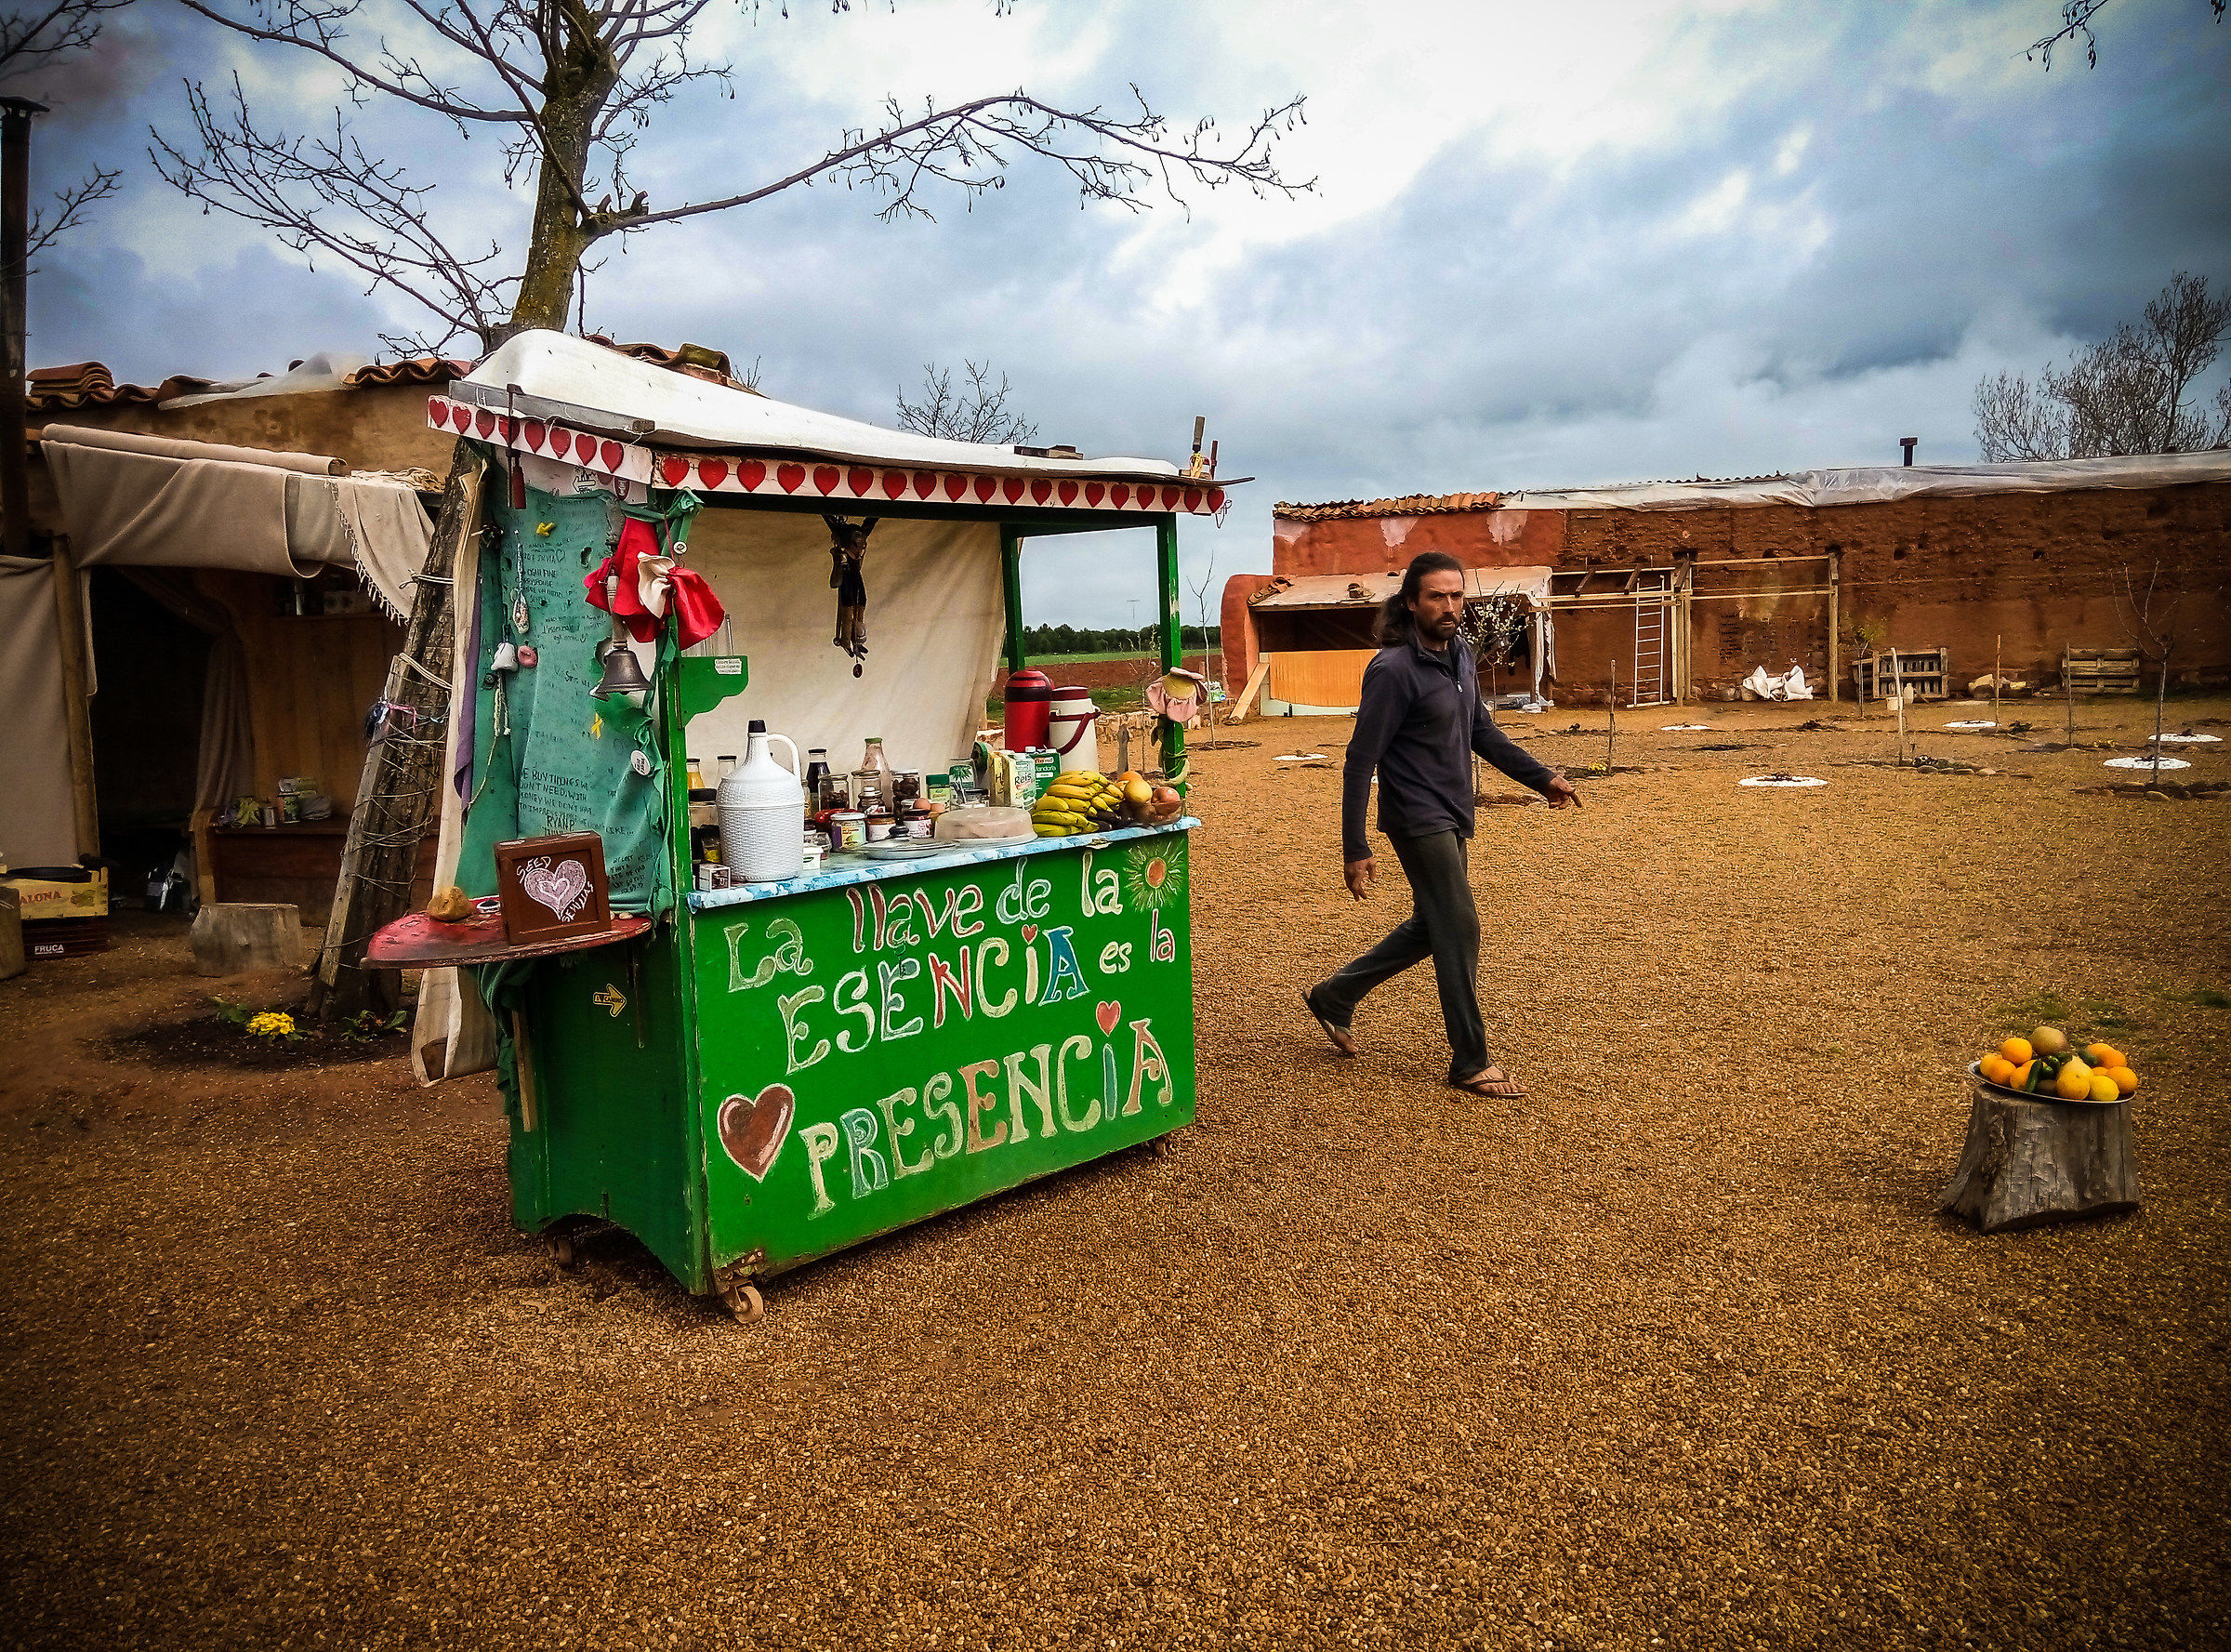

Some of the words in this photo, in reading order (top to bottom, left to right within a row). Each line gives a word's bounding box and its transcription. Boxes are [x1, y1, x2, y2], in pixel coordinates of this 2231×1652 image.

[533, 770, 548, 781] BUY
[1014, 772, 1032, 786] Reis
[516, 855, 552, 884] SEED
[723, 918, 813, 993] La
[845, 885, 983, 953] llave
[995, 857, 1051, 924] de
[1081, 852, 1123, 918] la
[35, 944, 64, 953] FRUCA
[776, 924, 1090, 1075] ESENCIA
[1099, 940, 1132, 974] es
[1150, 909, 1176, 963] la
[799, 1017, 1173, 1221] PRESENCIA
